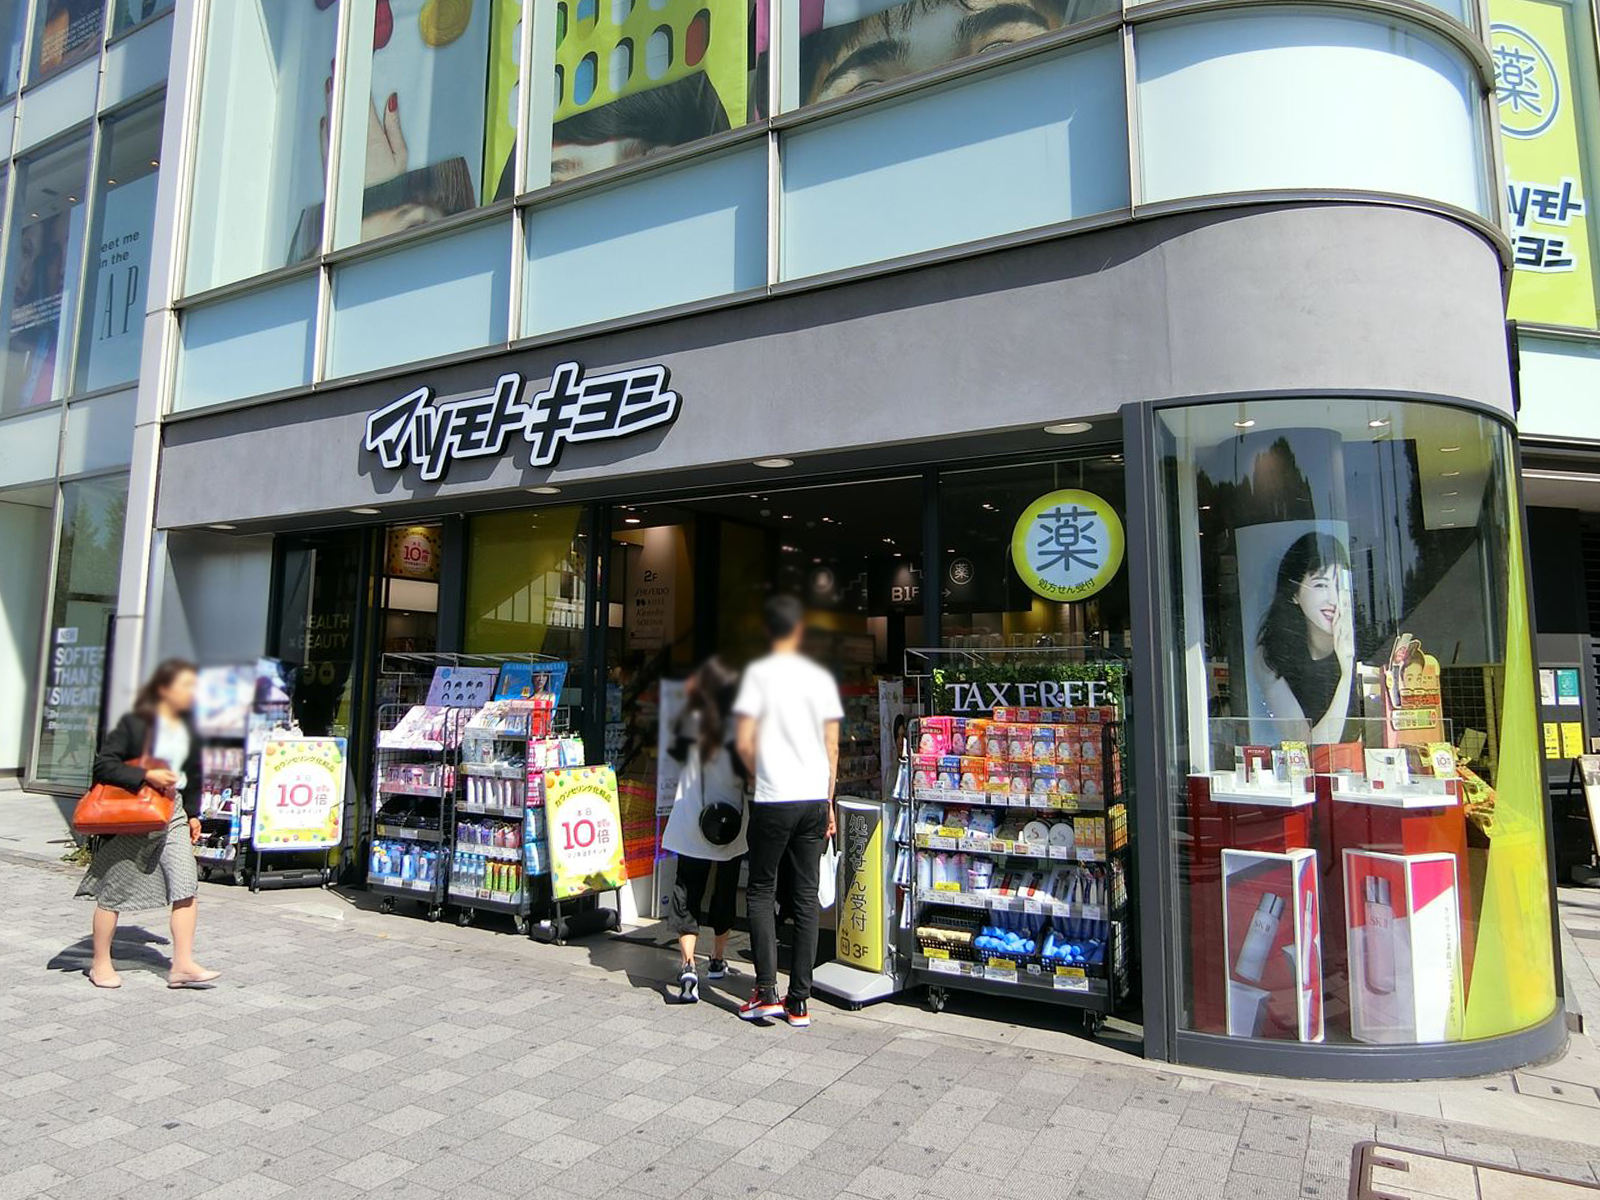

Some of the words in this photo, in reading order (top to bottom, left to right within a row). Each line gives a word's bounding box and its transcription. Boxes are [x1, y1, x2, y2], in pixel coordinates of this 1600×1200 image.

[122, 231, 140, 245] me
[111, 251, 130, 265] the
[366, 361, 680, 481] マツモトキヨシ
[1036, 506, 1099, 572] 薬
[891, 586, 920, 602] B1F
[1037, 577, 1095, 594] 処方せん受付
[298, 613, 350, 630] HEALTH
[945, 682, 1011, 712] TAX
[849, 813, 868, 932] 処方せん受付
[852, 943, 869, 959] 3F
